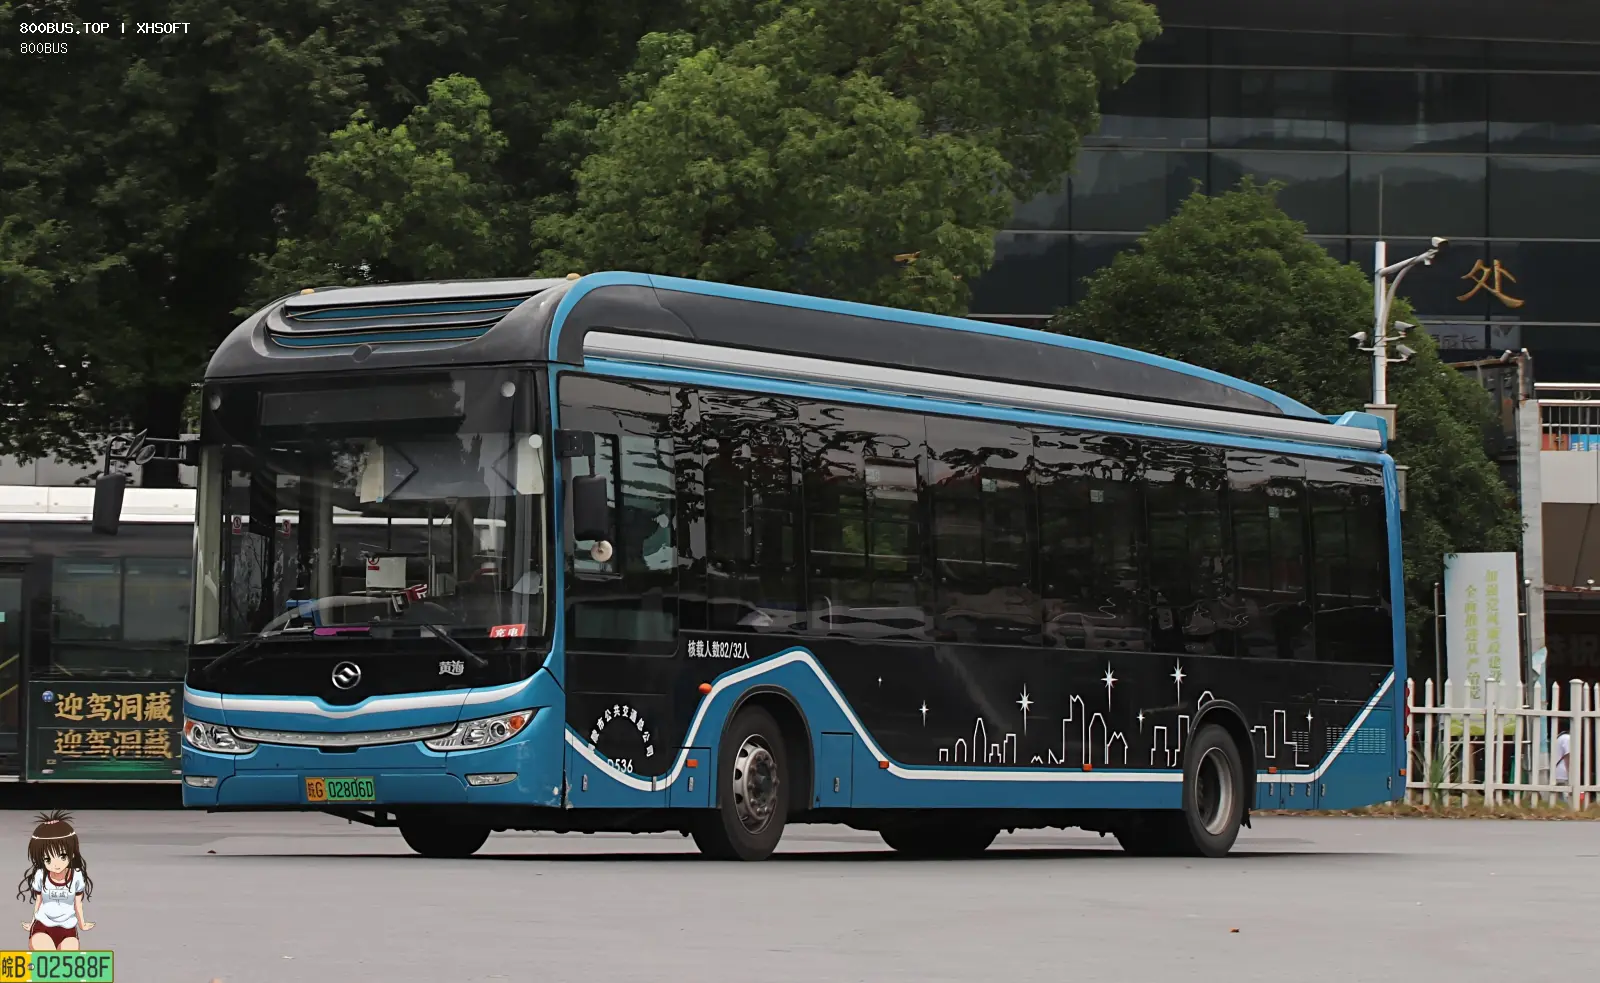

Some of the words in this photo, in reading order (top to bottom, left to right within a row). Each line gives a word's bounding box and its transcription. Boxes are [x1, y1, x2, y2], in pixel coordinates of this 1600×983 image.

[1456, 259, 1525, 309] 处
[495, 627, 519, 638] 充电
[687, 639, 750, 660] 核载人数82/32人
[438, 660, 465, 676] 黄海
[53, 691, 174, 723] 迎驾洞藏
[328, 781, 374, 798] 02806D
